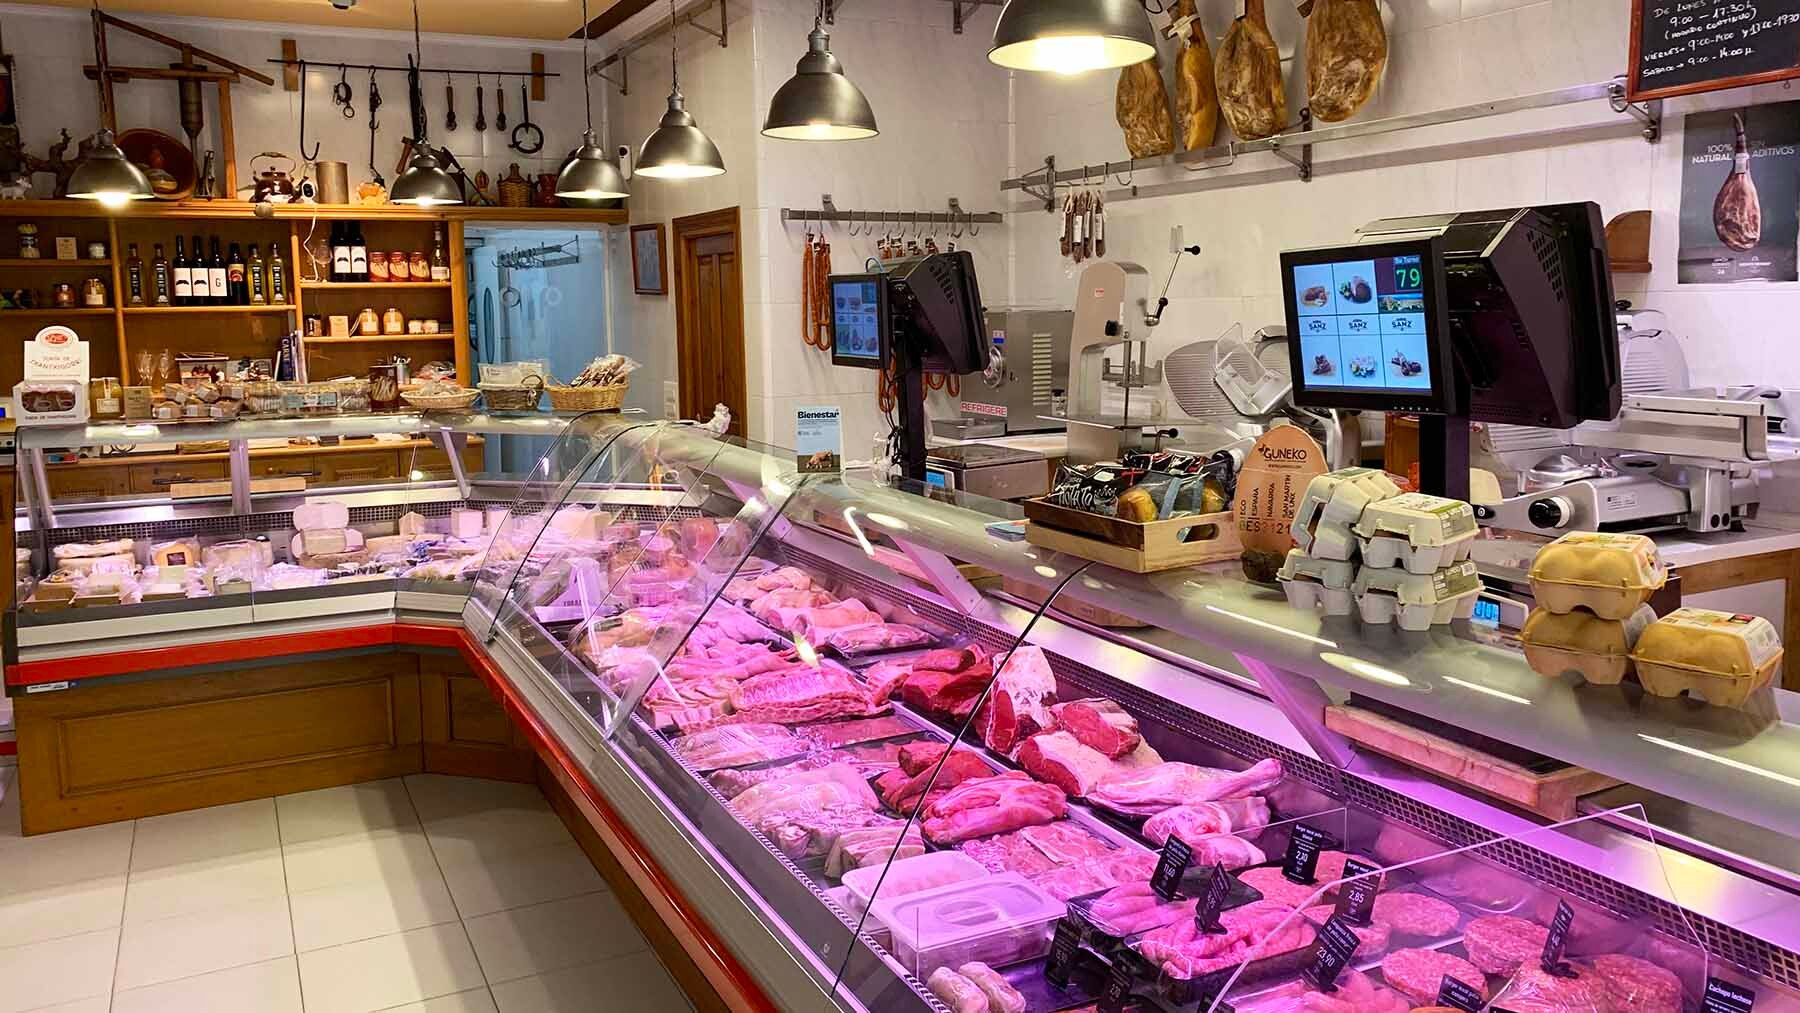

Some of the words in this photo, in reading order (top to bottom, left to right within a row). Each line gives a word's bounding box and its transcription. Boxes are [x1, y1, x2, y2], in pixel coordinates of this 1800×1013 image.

[1670, 15, 1693, 27] 9:00
[1707, 143, 1732, 153] 100%
[1752, 146, 1795, 158] ADITIVOS
[1692, 153, 1732, 164] NATURAL
[1396, 268, 1420, 288] 79
[1309, 322, 1327, 331] SANZ
[1348, 321, 1368, 330] SANZ
[1391, 320, 1412, 329] SANZ
[1263, 448, 1307, 460] GUNEKO
[1267, 482, 1276, 517] NAVARRA
[1348, 889, 1364, 904] 2,85
[1316, 946, 1336, 967] 23,90
[1708, 983, 1731, 998] Cachopo
